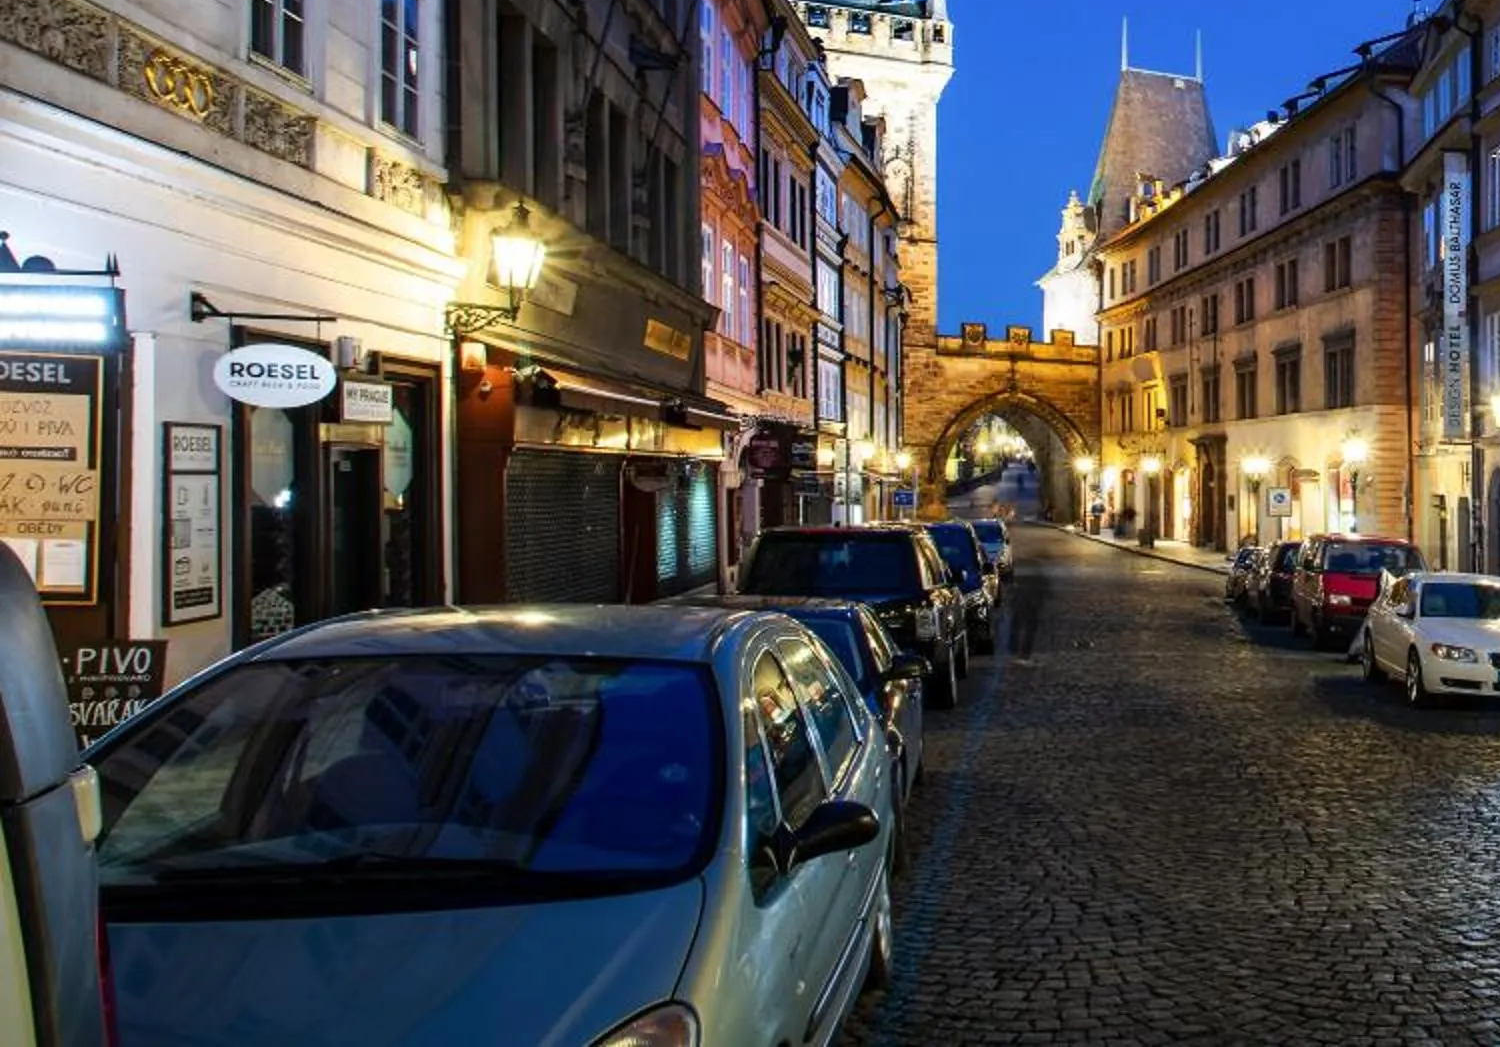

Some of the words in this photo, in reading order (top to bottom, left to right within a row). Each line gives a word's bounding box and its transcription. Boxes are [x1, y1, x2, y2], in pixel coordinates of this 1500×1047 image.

[1449, 182, 1461, 252] BALTHASAR
[1449, 255, 1461, 305] DOMUS
[1448, 324, 1461, 374] HOTEL
[229, 361, 320, 380] ROESEL
[173, 436, 213, 453] ROESEL
[59, 473, 94, 494] WC
[77, 647, 152, 674] PIVO
